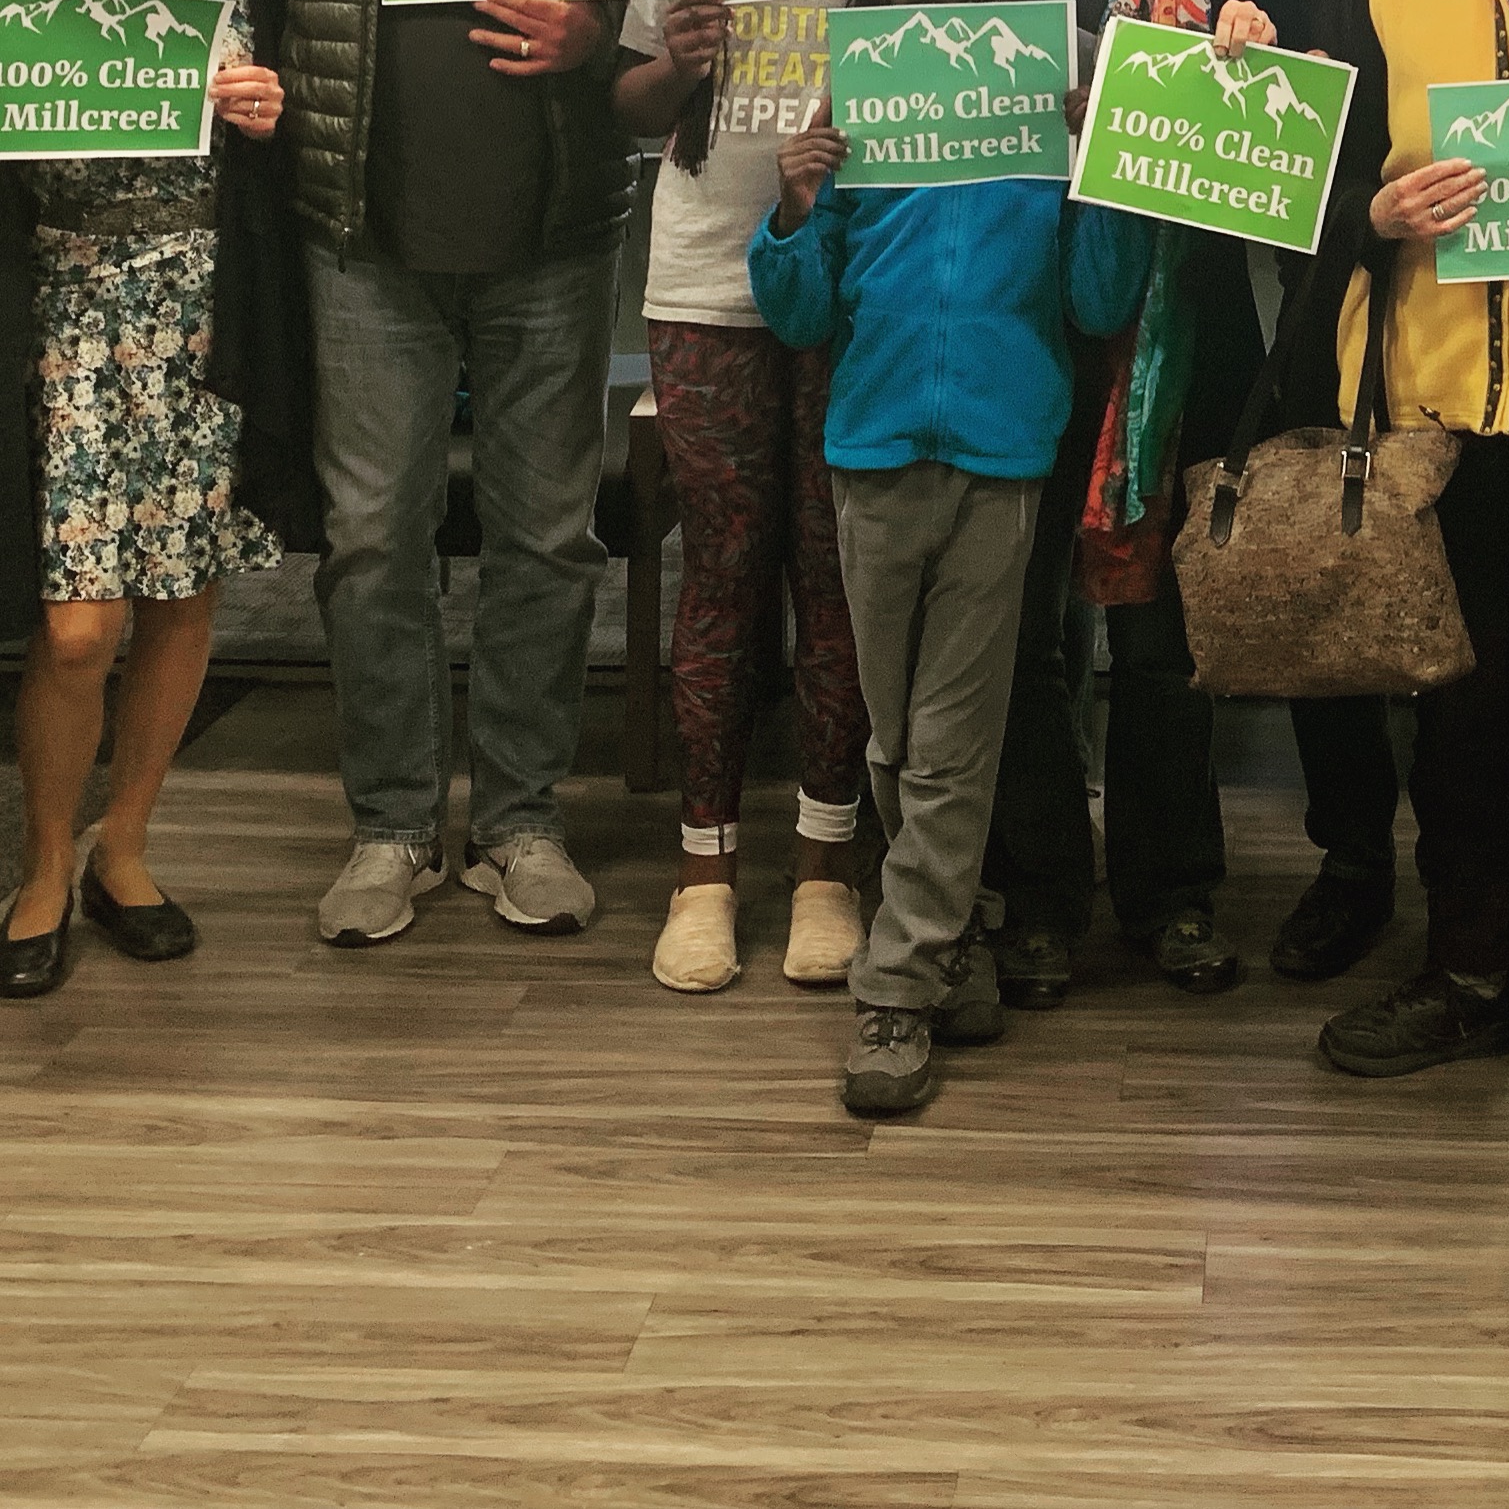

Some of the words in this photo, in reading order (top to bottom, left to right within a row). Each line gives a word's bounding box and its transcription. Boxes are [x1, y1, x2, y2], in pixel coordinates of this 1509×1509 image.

[99, 57, 200, 89] Clean
[1, 100, 182, 132] Millcreek
[845, 92, 944, 124] 100%
[954, 86, 1056, 119] Clean
[863, 126, 1043, 163] Millcreek
[1107, 107, 1205, 151] 100%
[1214, 129, 1315, 180] Clean
[1111, 151, 1292, 220] Millcreek
